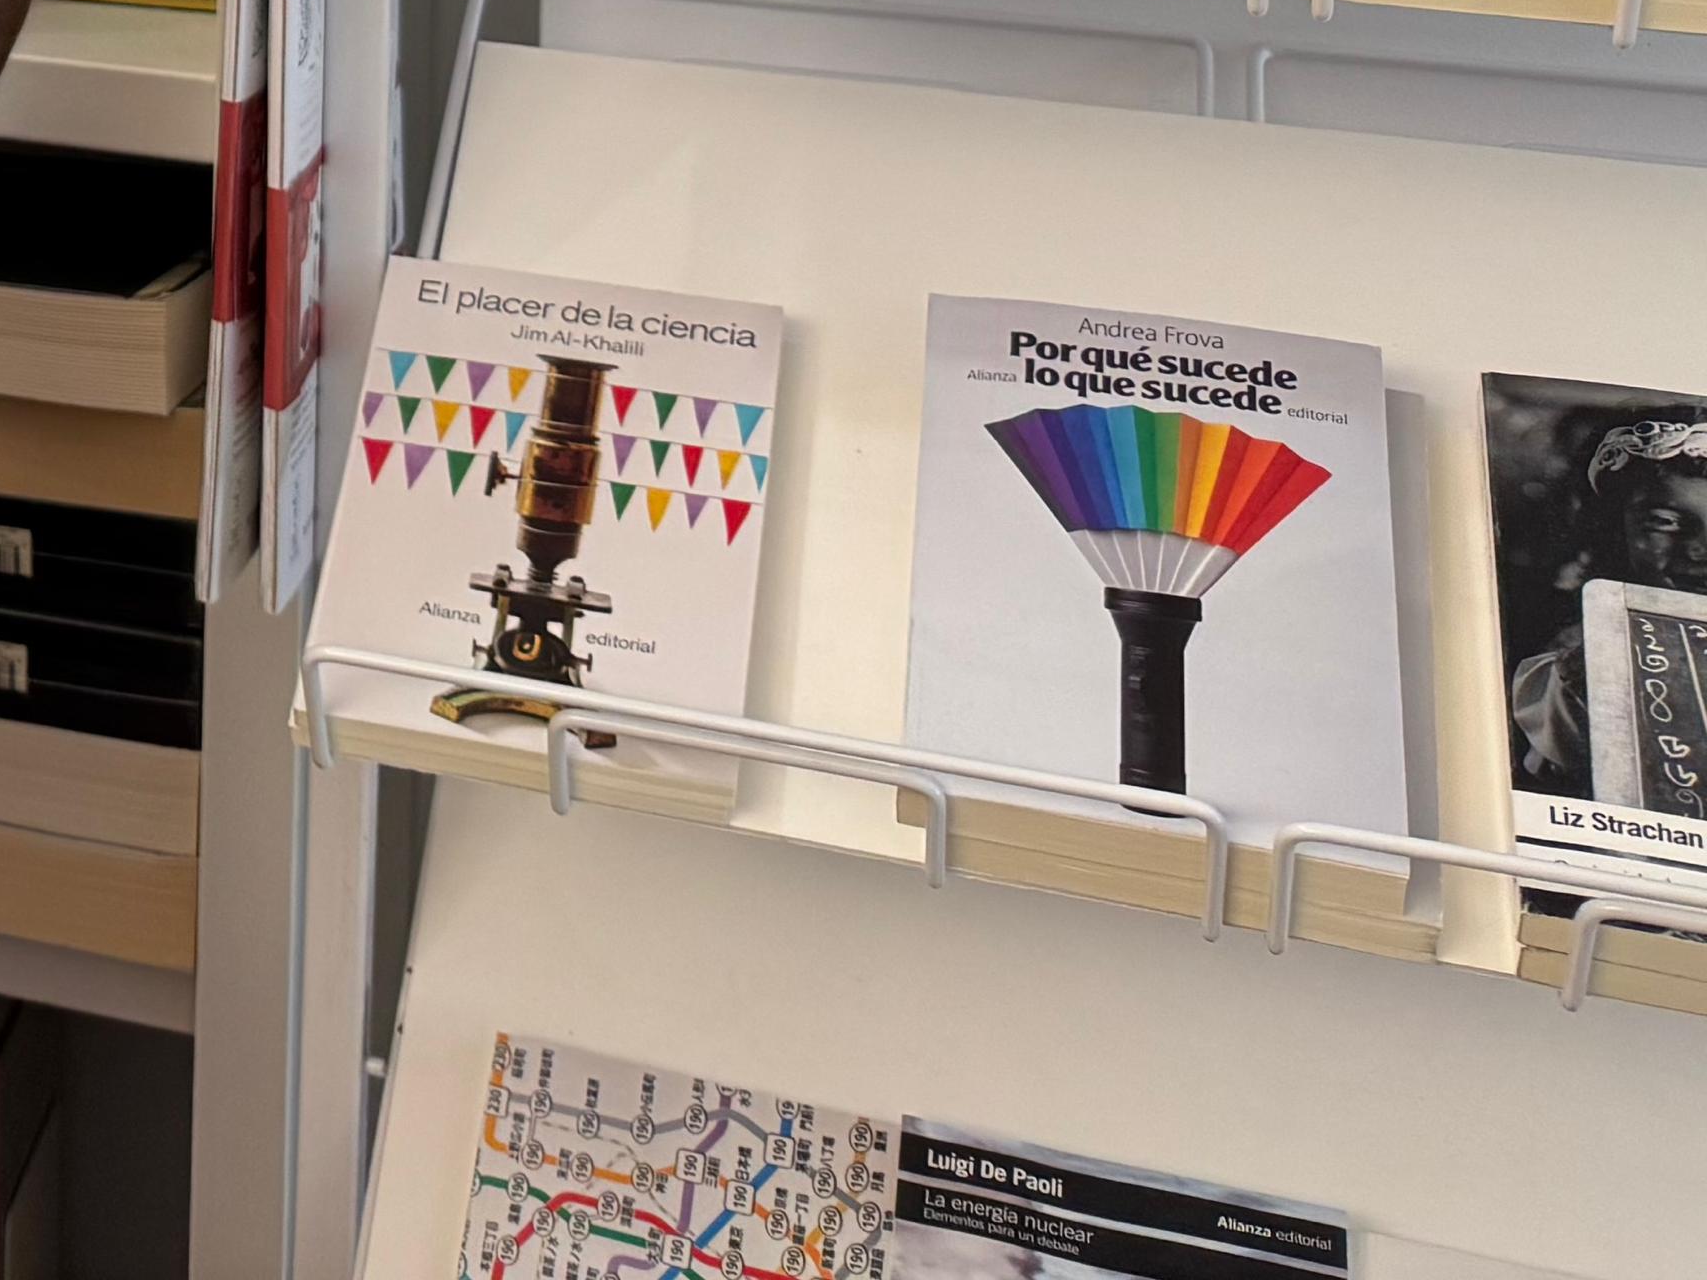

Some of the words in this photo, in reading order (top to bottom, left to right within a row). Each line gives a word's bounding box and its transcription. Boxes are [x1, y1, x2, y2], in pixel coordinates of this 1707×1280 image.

[417, 279, 449, 305] El
[456, 287, 554, 320] placer
[561, 299, 603, 327] de
[607, 304, 634, 332] la
[641, 313, 758, 349] ciencia
[1078, 317, 1157, 342] Andrea
[1165, 326, 1224, 350] Frova
[511, 325, 548, 344] Jim
[551, 331, 644, 358] Al-Khalili
[1010, 331, 1077, 363] Por
[1081, 345, 1153, 373] qué
[1158, 352, 1298, 390] sucede
[967, 369, 1017, 384] Alianza
[1025, 359, 1060, 387] lo
[1065, 370, 1135, 398] que
[1141, 379, 1282, 415] sucede
[1287, 407, 1349, 425] editorial
[419, 601, 481, 625] Alianza
[585, 630, 656, 655] editorial
[1550, 805, 1585, 829] Liz
[1592, 812, 1704, 849] Strachan
[684, 1154, 698, 1178] 190
[927, 1148, 974, 1178] Luigi
[980, 1160, 1007, 1183] De
[1013, 1167, 1063, 1198] Paoli
[923, 1207, 984, 1230] Elementos
[988, 1221, 1016, 1240] para
[1018, 1231, 1035, 1244] un
[1037, 1235, 1080, 1256] debate
[925, 1189, 945, 1209] La
[951, 1195, 1018, 1226] energía
[1024, 1214, 1094, 1245] nuclear
[1217, 1215, 1272, 1238] Alianza
[1275, 1228, 1333, 1252] editorial
